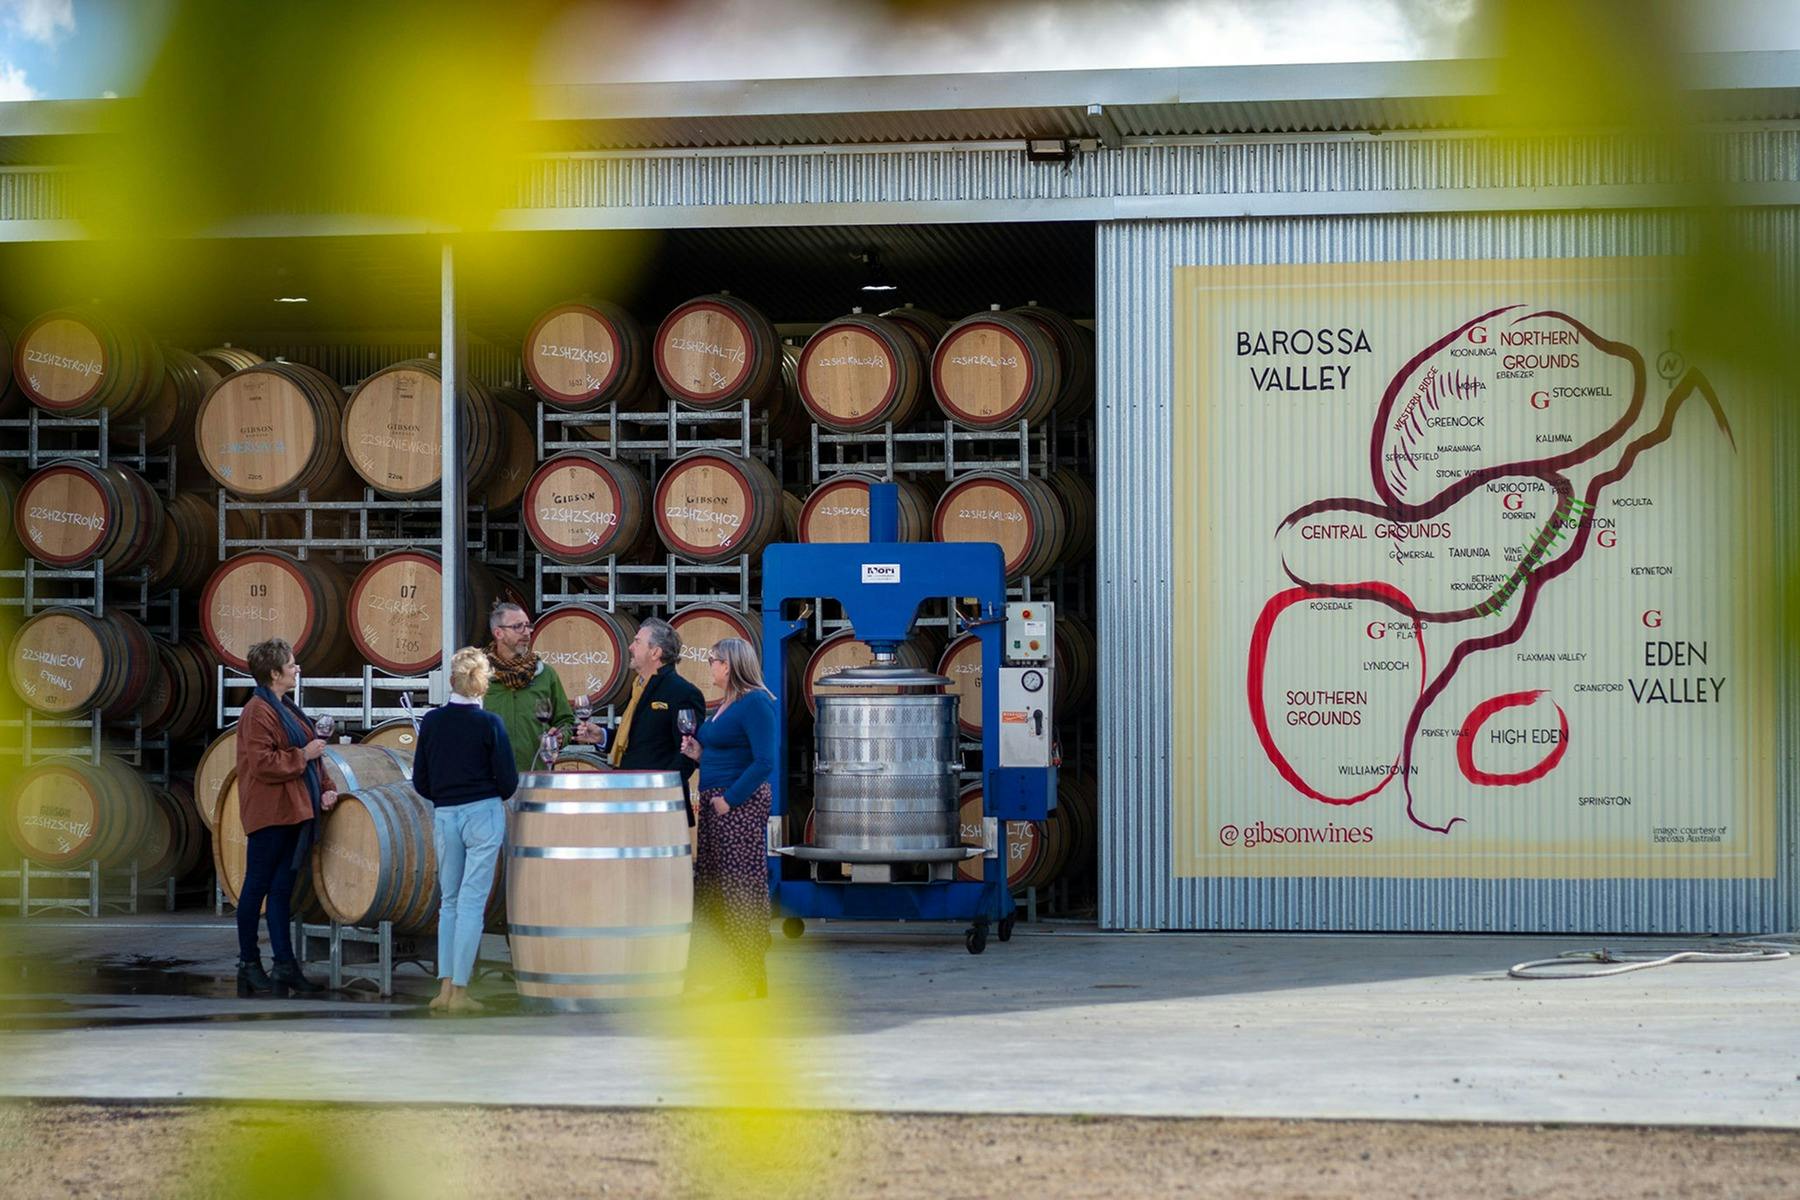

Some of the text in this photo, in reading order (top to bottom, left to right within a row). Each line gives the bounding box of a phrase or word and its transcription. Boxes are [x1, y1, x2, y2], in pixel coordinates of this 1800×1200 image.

[1467, 326, 1488, 344] G
[1500, 330, 1579, 345] NORTHERN
[1237, 329, 1372, 356] BAROSSA
[1450, 348, 1497, 357] KOONUNGA
[1503, 354, 1579, 369] GROUNDS
[1250, 366, 1351, 391] VALLEY
[1496, 371, 1534, 379] EBENEZER
[1393, 365, 1439, 431] WESTERN RIDGE
[1552, 386, 1612, 398] STOCKWELL
[1530, 391, 1550, 410] G
[386, 423, 421, 432] GIBSON
[1427, 415, 1485, 428] GREENOCK
[240, 425, 273, 434] GIBSON
[1535, 434, 1572, 443] KALIMNA
[1436, 444, 1481, 452] MARANANGA
[1436, 469, 1462, 478] STONE
[1486, 482, 1546, 493] NURIOOTPA
[686, 496, 729, 505] GIBSON
[1503, 492, 1523, 511] G
[1612, 498, 1653, 507] MOCULTA
[1552, 518, 1616, 529] ANGATON
[1301, 522, 1451, 540] CENTRAL GROUNDS
[1597, 529, 1617, 548] G
[1389, 550, 1434, 559] GOMERSAL
[1448, 547, 1490, 558] TANUNDA
[1630, 566, 1673, 575] KEYNETON
[250, 584, 268, 598] 09
[400, 585, 417, 599] 07
[1310, 602, 1353, 610] ROSEDALE
[1642, 609, 1662, 628] G
[1366, 621, 1386, 639] G
[1517, 652, 1587, 662] FLAXMAN VALLEY
[1645, 641, 1708, 666] EDEN
[1363, 660, 1409, 671] LYNDOCH
[1628, 677, 1726, 704] VALLEY
[1286, 690, 1368, 706] SOUTHERN
[1286, 711, 1362, 726] GROUNDS
[1491, 729, 1569, 744] HIGH EDEN
[1578, 796, 1632, 806] SPRINGTON
